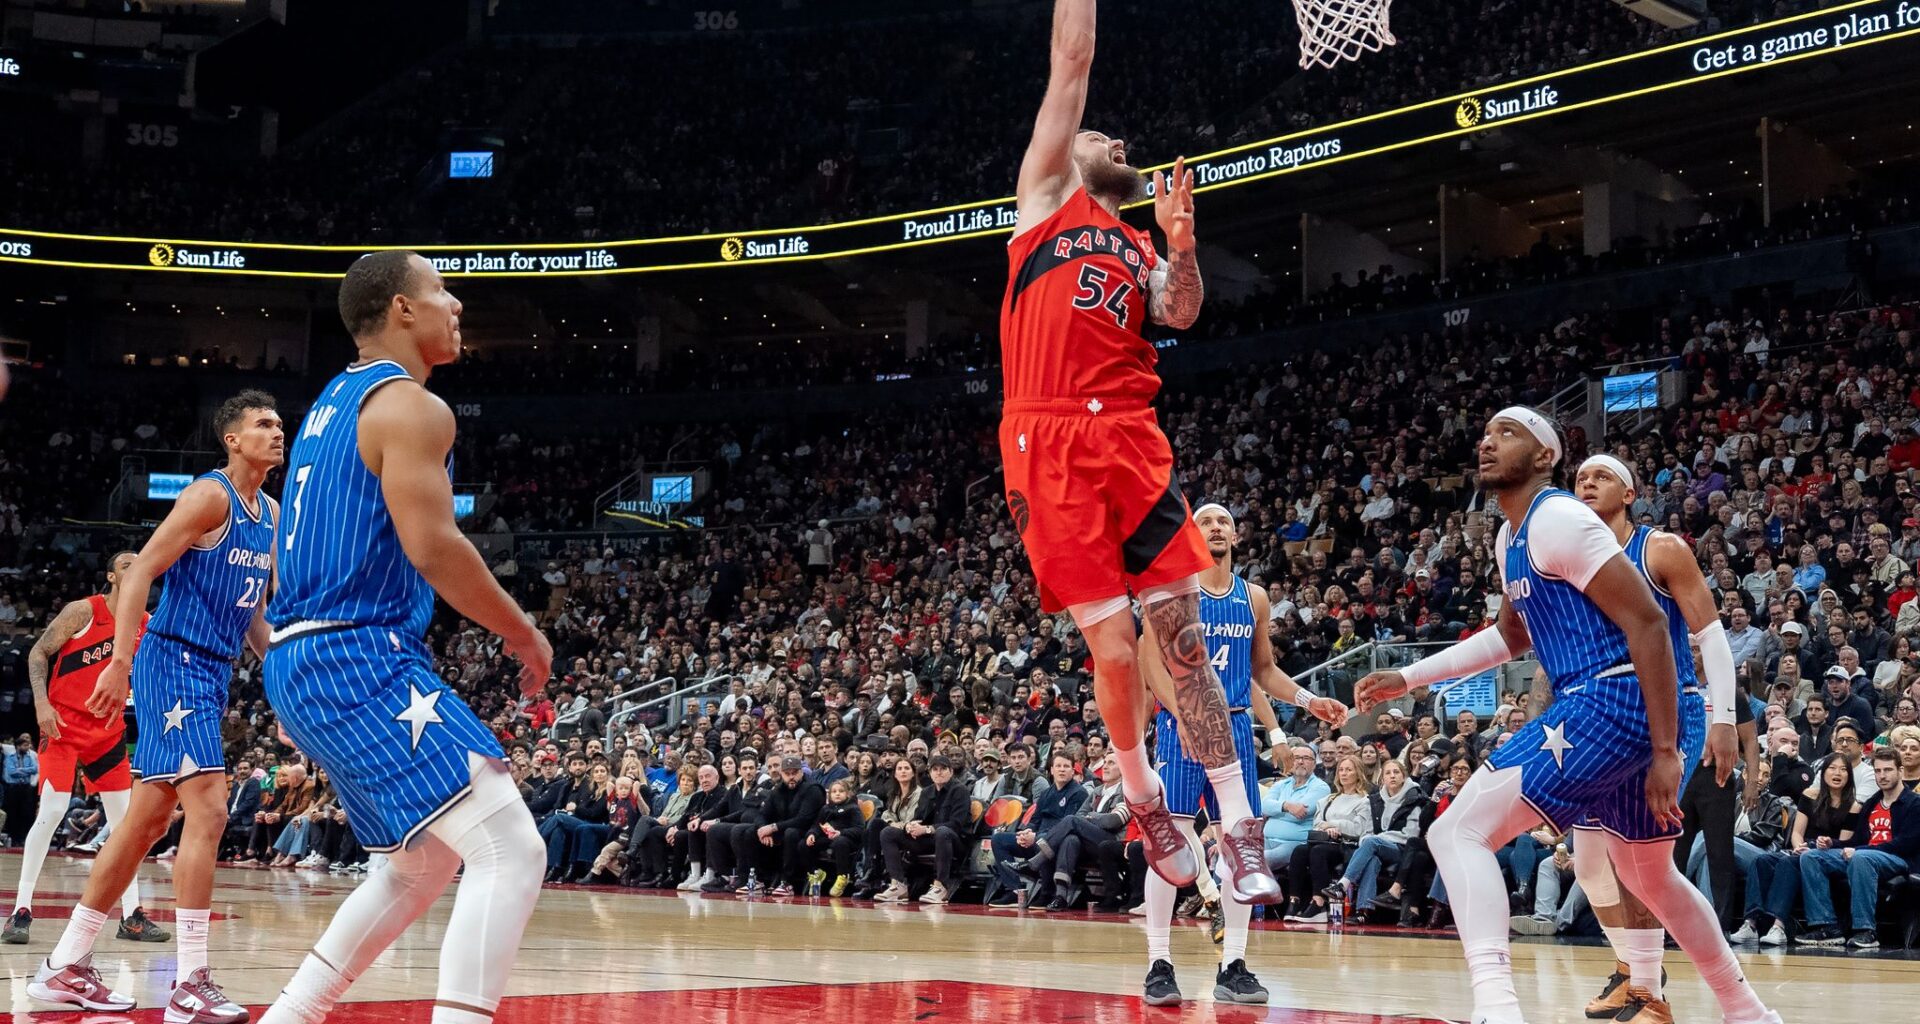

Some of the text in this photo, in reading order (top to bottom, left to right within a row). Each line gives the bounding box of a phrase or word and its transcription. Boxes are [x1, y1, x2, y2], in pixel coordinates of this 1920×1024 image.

[693, 10, 739, 30] 306
[1693, 45, 1737, 72] Get
[1742, 44, 1756, 62] a
[1761, 28, 1828, 63] game
[1834, 14, 1891, 48] plan
[1485, 85, 1558, 119] Sun Life
[126, 122, 179, 147] 305
[904, 216, 955, 240] Proud
[957, 209, 992, 232] Life
[1196, 156, 1266, 188] Toronto
[1268, 138, 1341, 171] Raptors
[0, 241, 31, 257] ors
[746, 236, 809, 257] Sun Life
[177, 250, 245, 269] Sun Life
[465, 252, 504, 274] plan
[509, 252, 535, 271] for
[537, 256, 582, 273] your
[585, 249, 618, 269] life.
[1072, 263, 1134, 330] 54
[1443, 308, 1471, 327] 107
[964, 379, 988, 394] 106
[455, 403, 482, 417] 105
[236, 576, 264, 609] 23
[82, 642, 113, 665] RAP
[1210, 644, 1231, 671] 4
